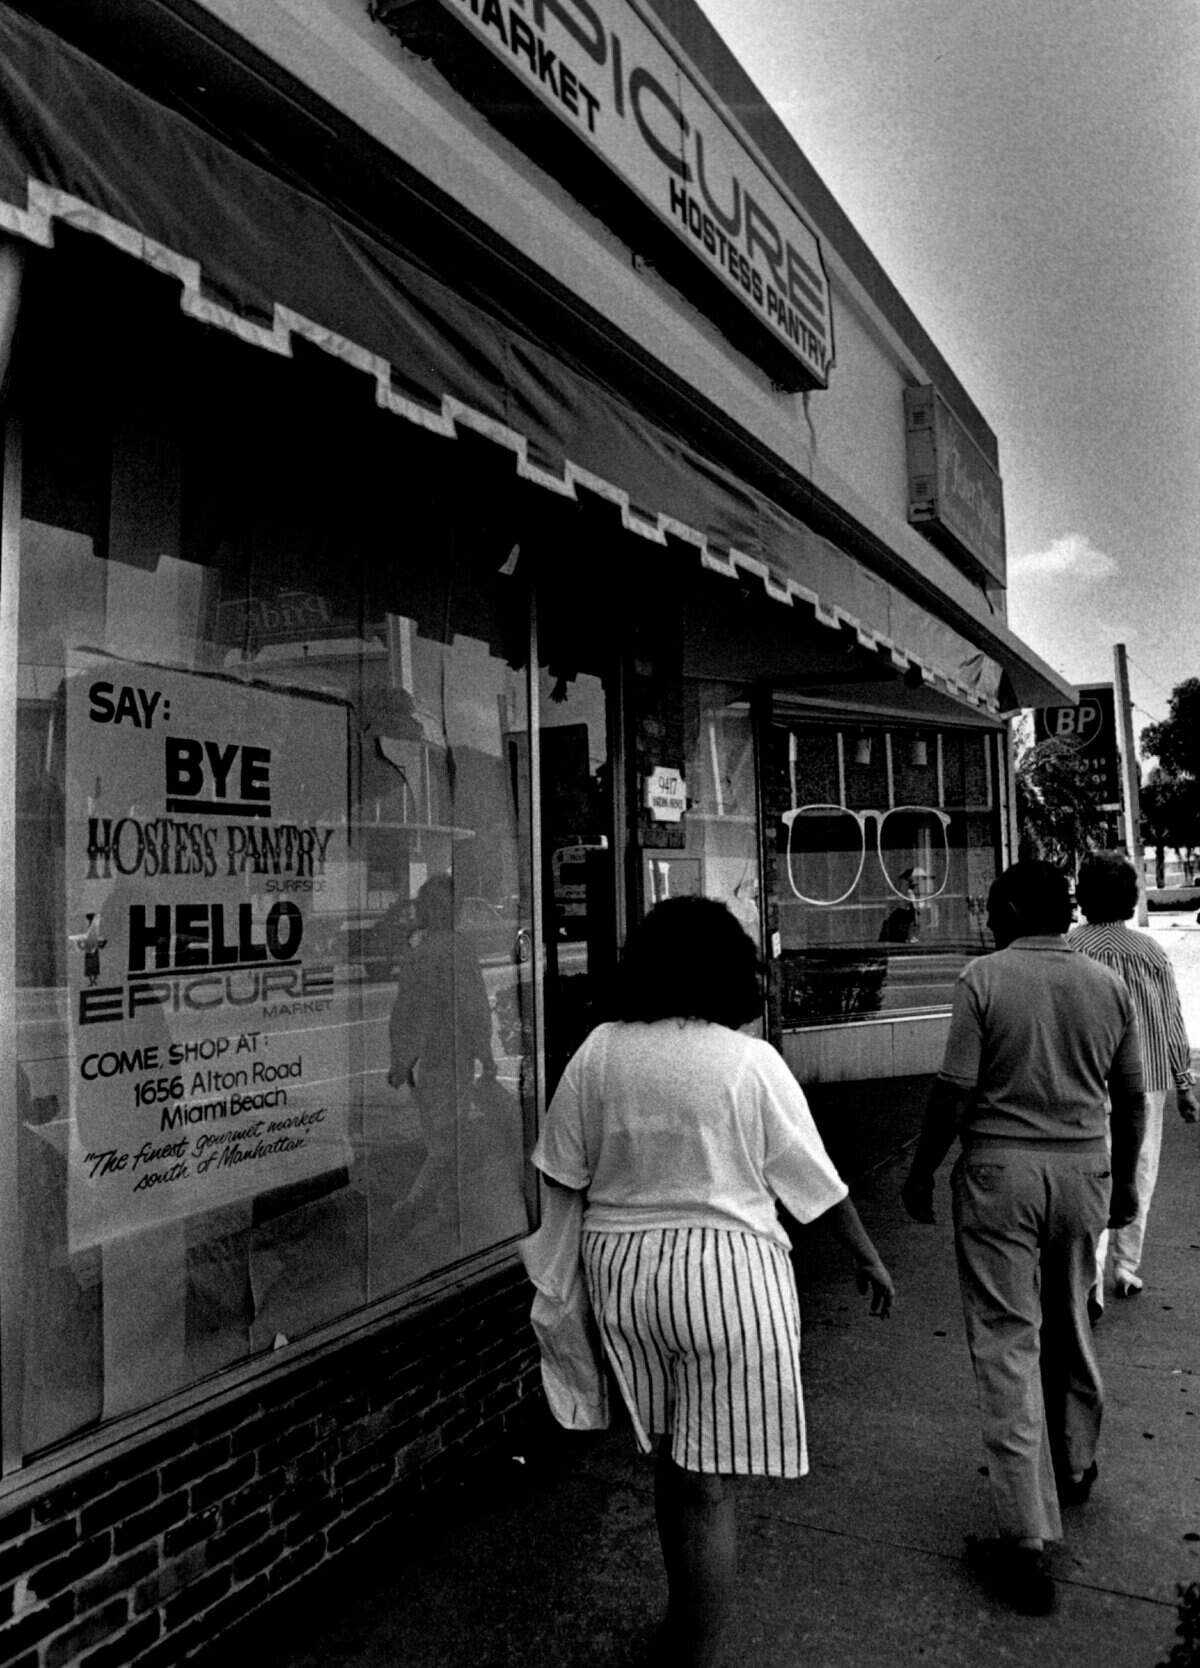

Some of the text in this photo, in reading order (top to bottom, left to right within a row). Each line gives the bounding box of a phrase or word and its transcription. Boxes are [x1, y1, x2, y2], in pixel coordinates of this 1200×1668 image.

[461, 0, 601, 133] ARKET
[669, 177, 827, 373] HOSTESS PANTRY
[89, 682, 170, 729] SAY:
[1056, 707, 1096, 735] BP
[165, 737, 272, 801] BYE
[86, 818, 335, 879] HOSTESS PANTRY
[129, 901, 303, 972] HELLO
[79, 966, 334, 1026] EPICURE
[262, 1000, 334, 1019] MARKET
[168, 1038, 230, 1066] SHOP
[134, 1056, 302, 1107] 1656 Alton Road
[160, 1087, 287, 1131] Miami Beach
[132, 1137, 190, 1171] finest
[192, 1120, 264, 1157] gourmet
[267, 1108, 328, 1133] market
[133, 1163, 190, 1192] south
[197, 1154, 218, 1174] of
